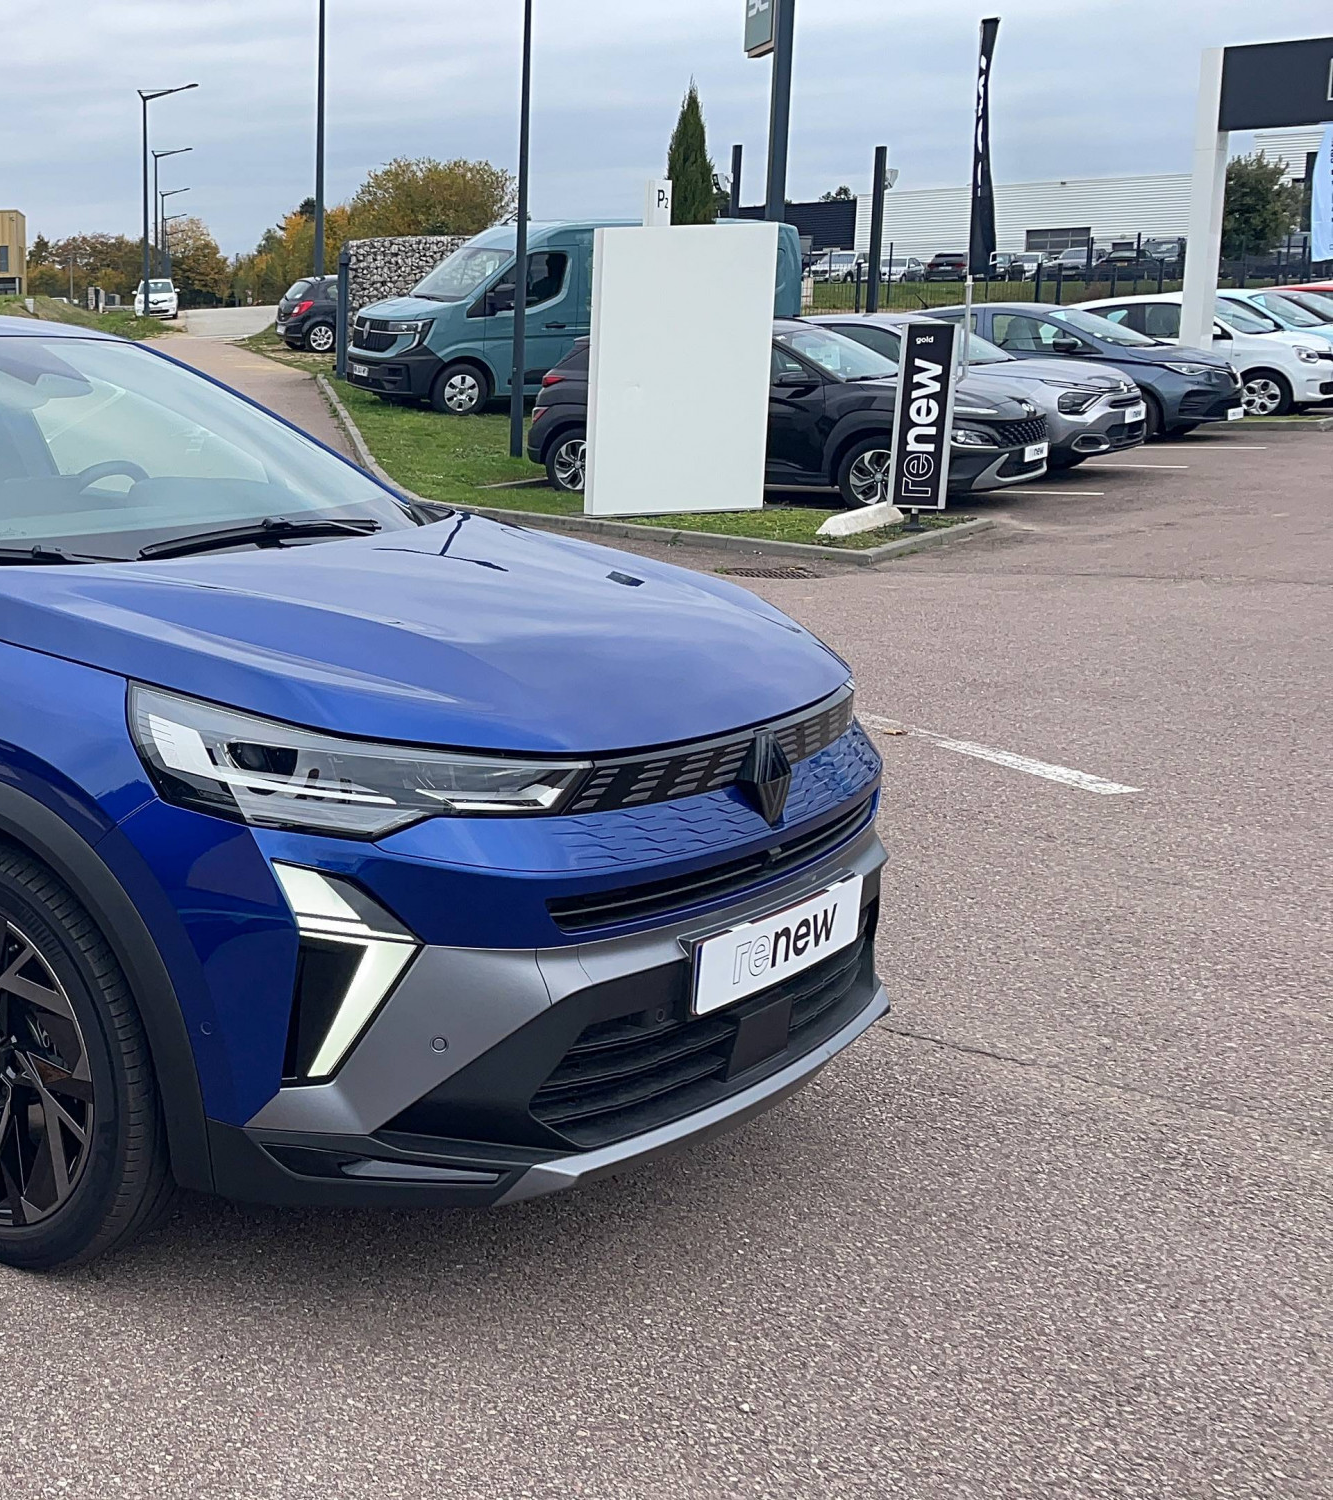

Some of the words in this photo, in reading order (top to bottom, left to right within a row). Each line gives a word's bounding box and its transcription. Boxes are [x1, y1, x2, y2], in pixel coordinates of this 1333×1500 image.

[657, 189, 669, 209] P2
[915, 336, 934, 345] gold
[901, 357, 944, 497] renew
[732, 902, 838, 985] renew
